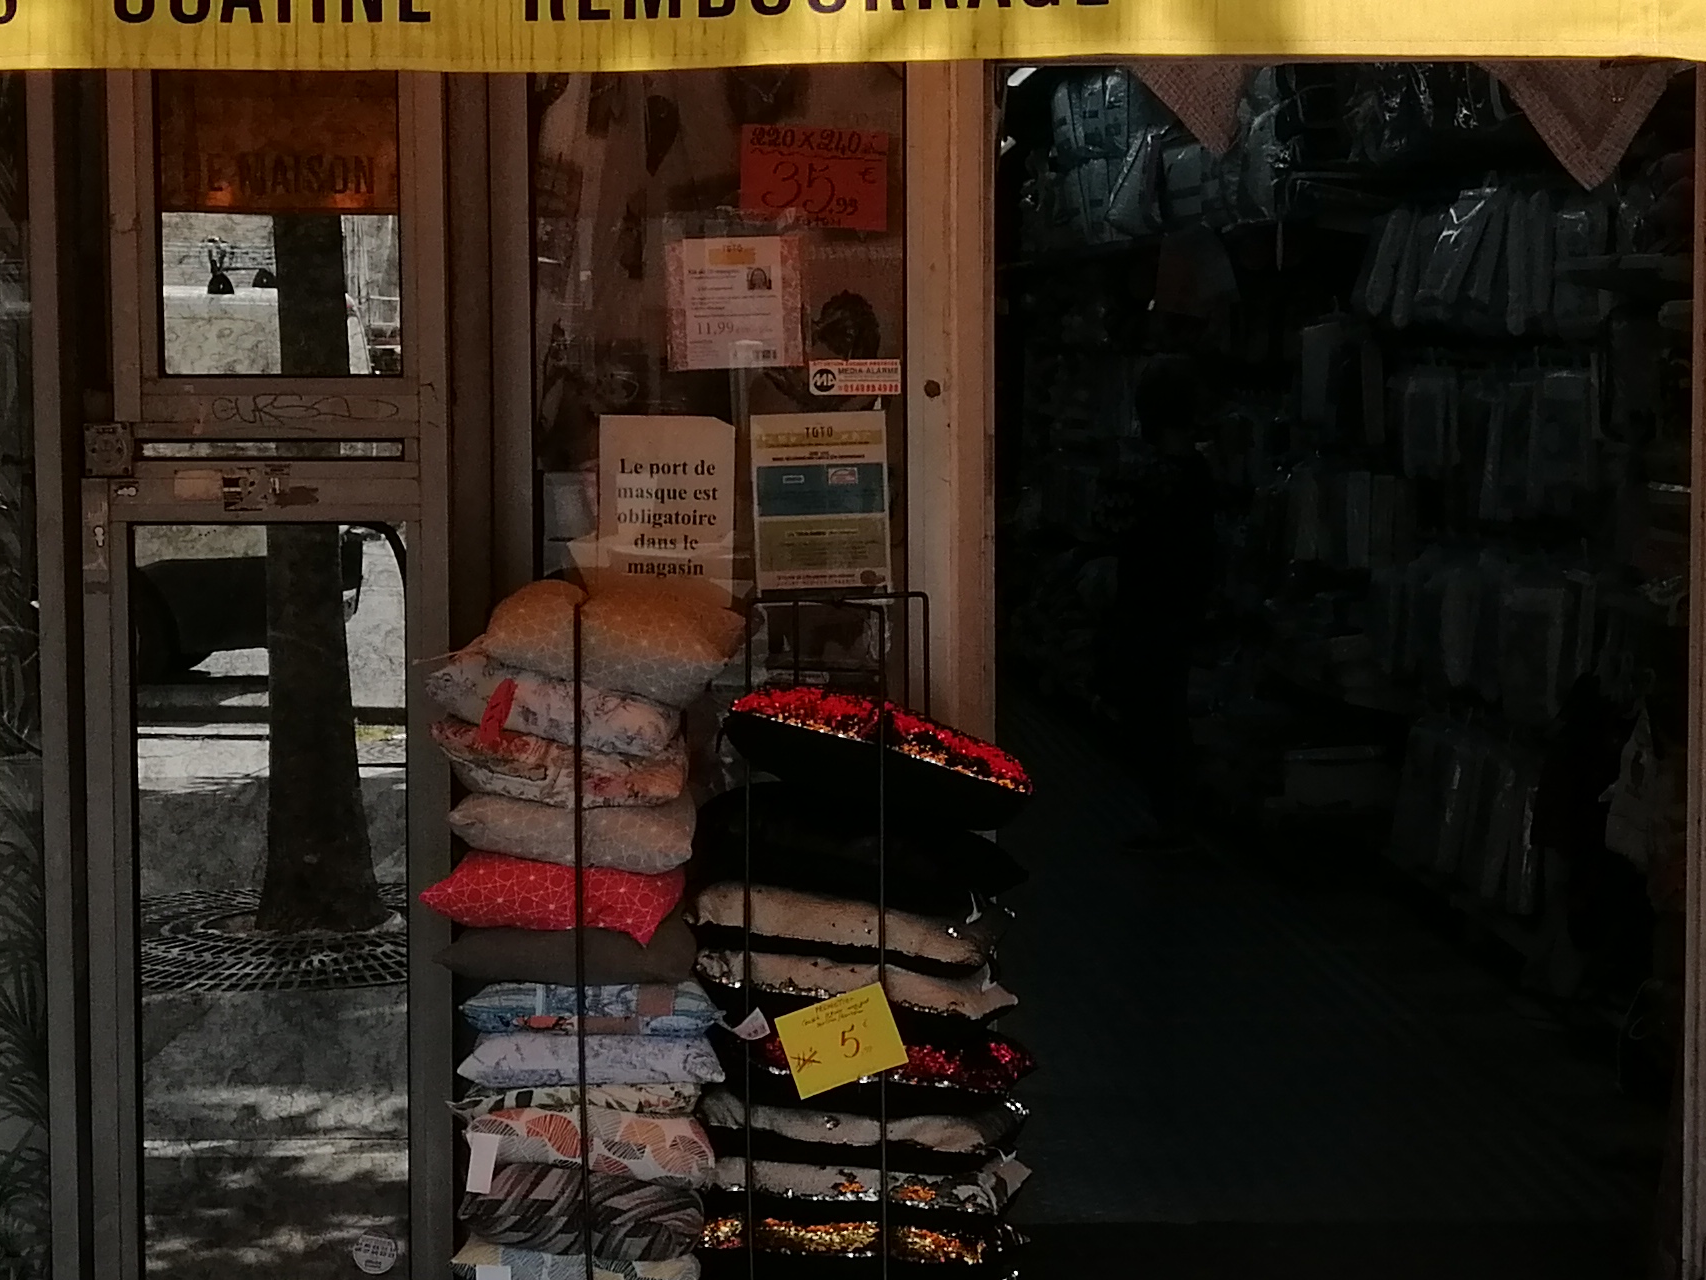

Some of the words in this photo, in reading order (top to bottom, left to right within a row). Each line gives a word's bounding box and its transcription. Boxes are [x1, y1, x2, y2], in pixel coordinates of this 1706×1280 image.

[619, 458, 643, 475] Le
[649, 461, 688, 478] port
[693, 459, 716, 476] de
[617, 486, 688, 504] masque
[692, 487, 718, 501] est
[617, 508, 717, 529] obligatoire
[633, 533, 677, 550] dans
[683, 534, 699, 551] le
[627, 558, 704, 578] magasin
